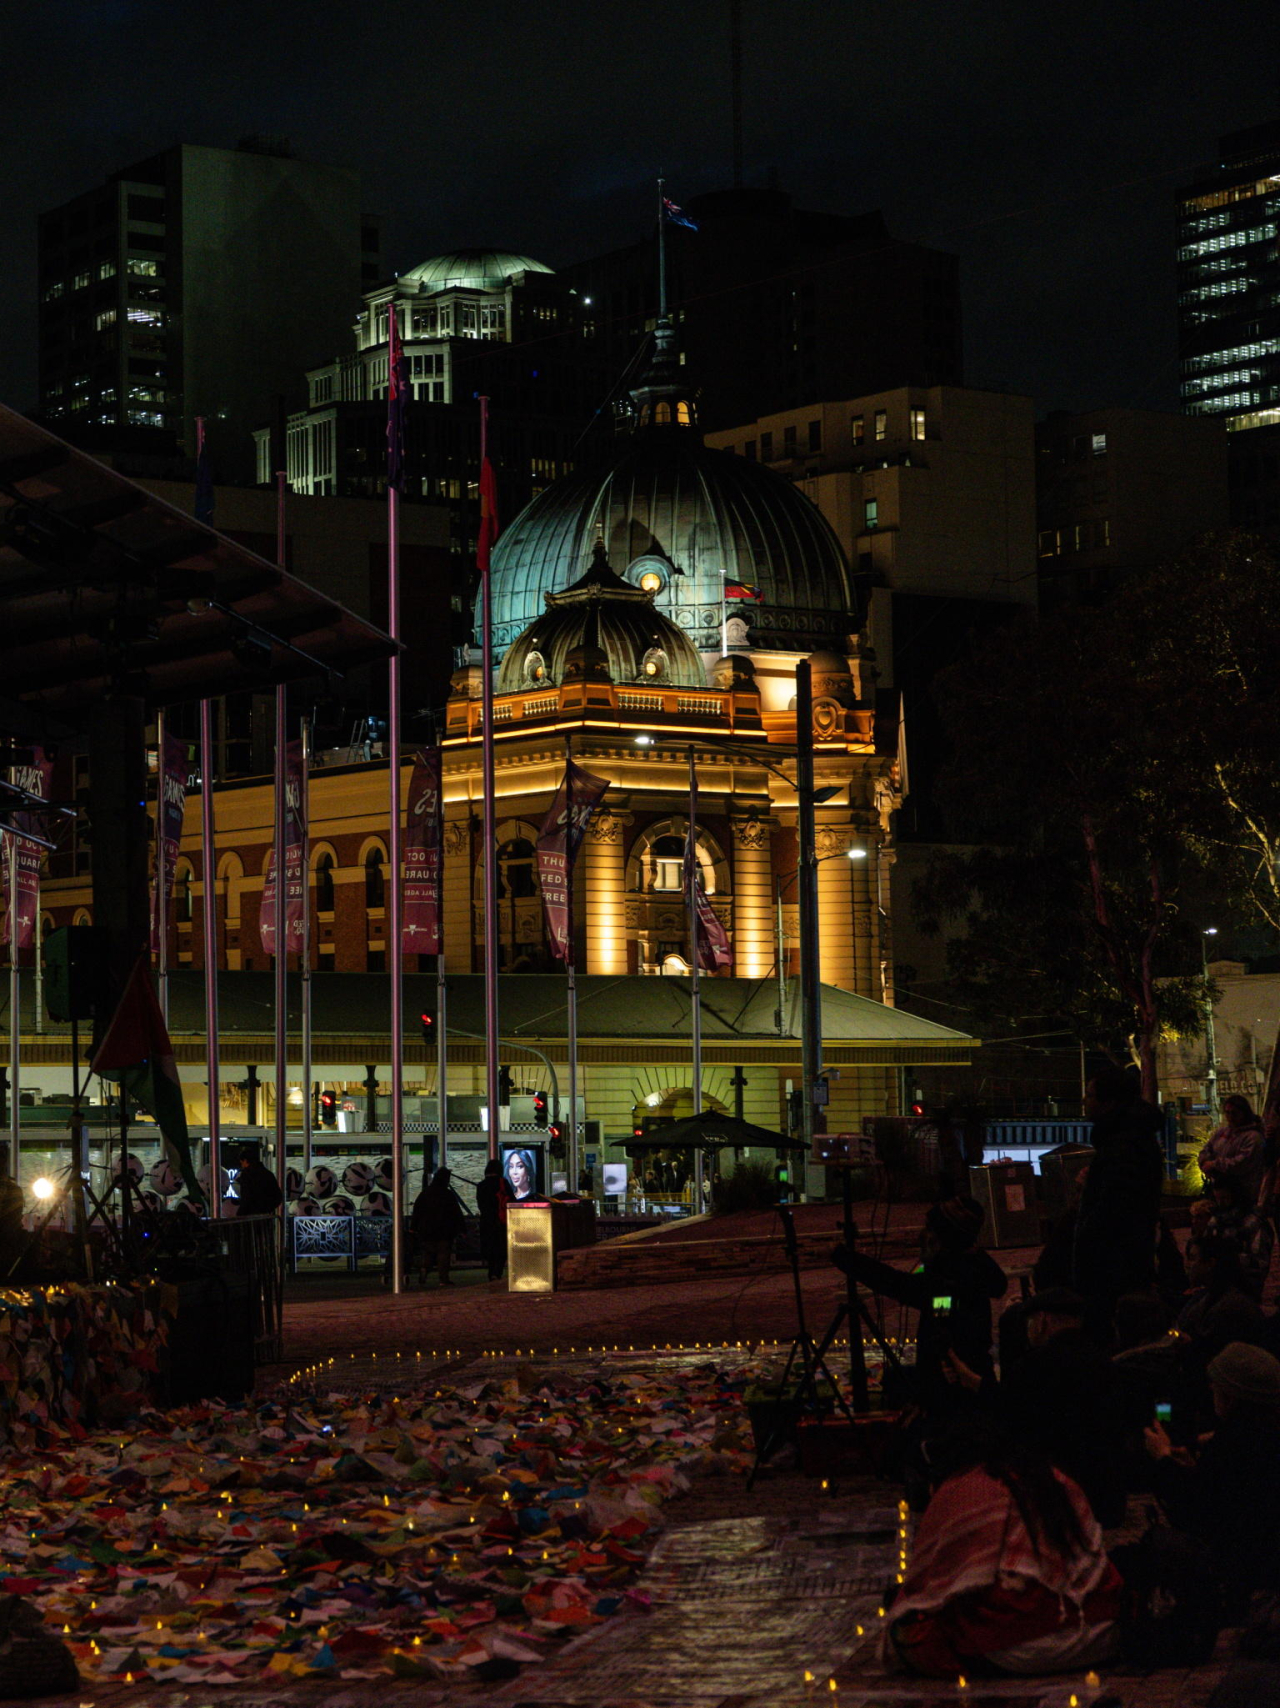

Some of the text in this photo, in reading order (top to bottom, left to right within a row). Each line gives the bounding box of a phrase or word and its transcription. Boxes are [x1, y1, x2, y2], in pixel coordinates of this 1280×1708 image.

[542, 856, 565, 867] THU
[541, 873, 562, 884] FED
[595, 1226, 637, 1234] ELBOURNE
